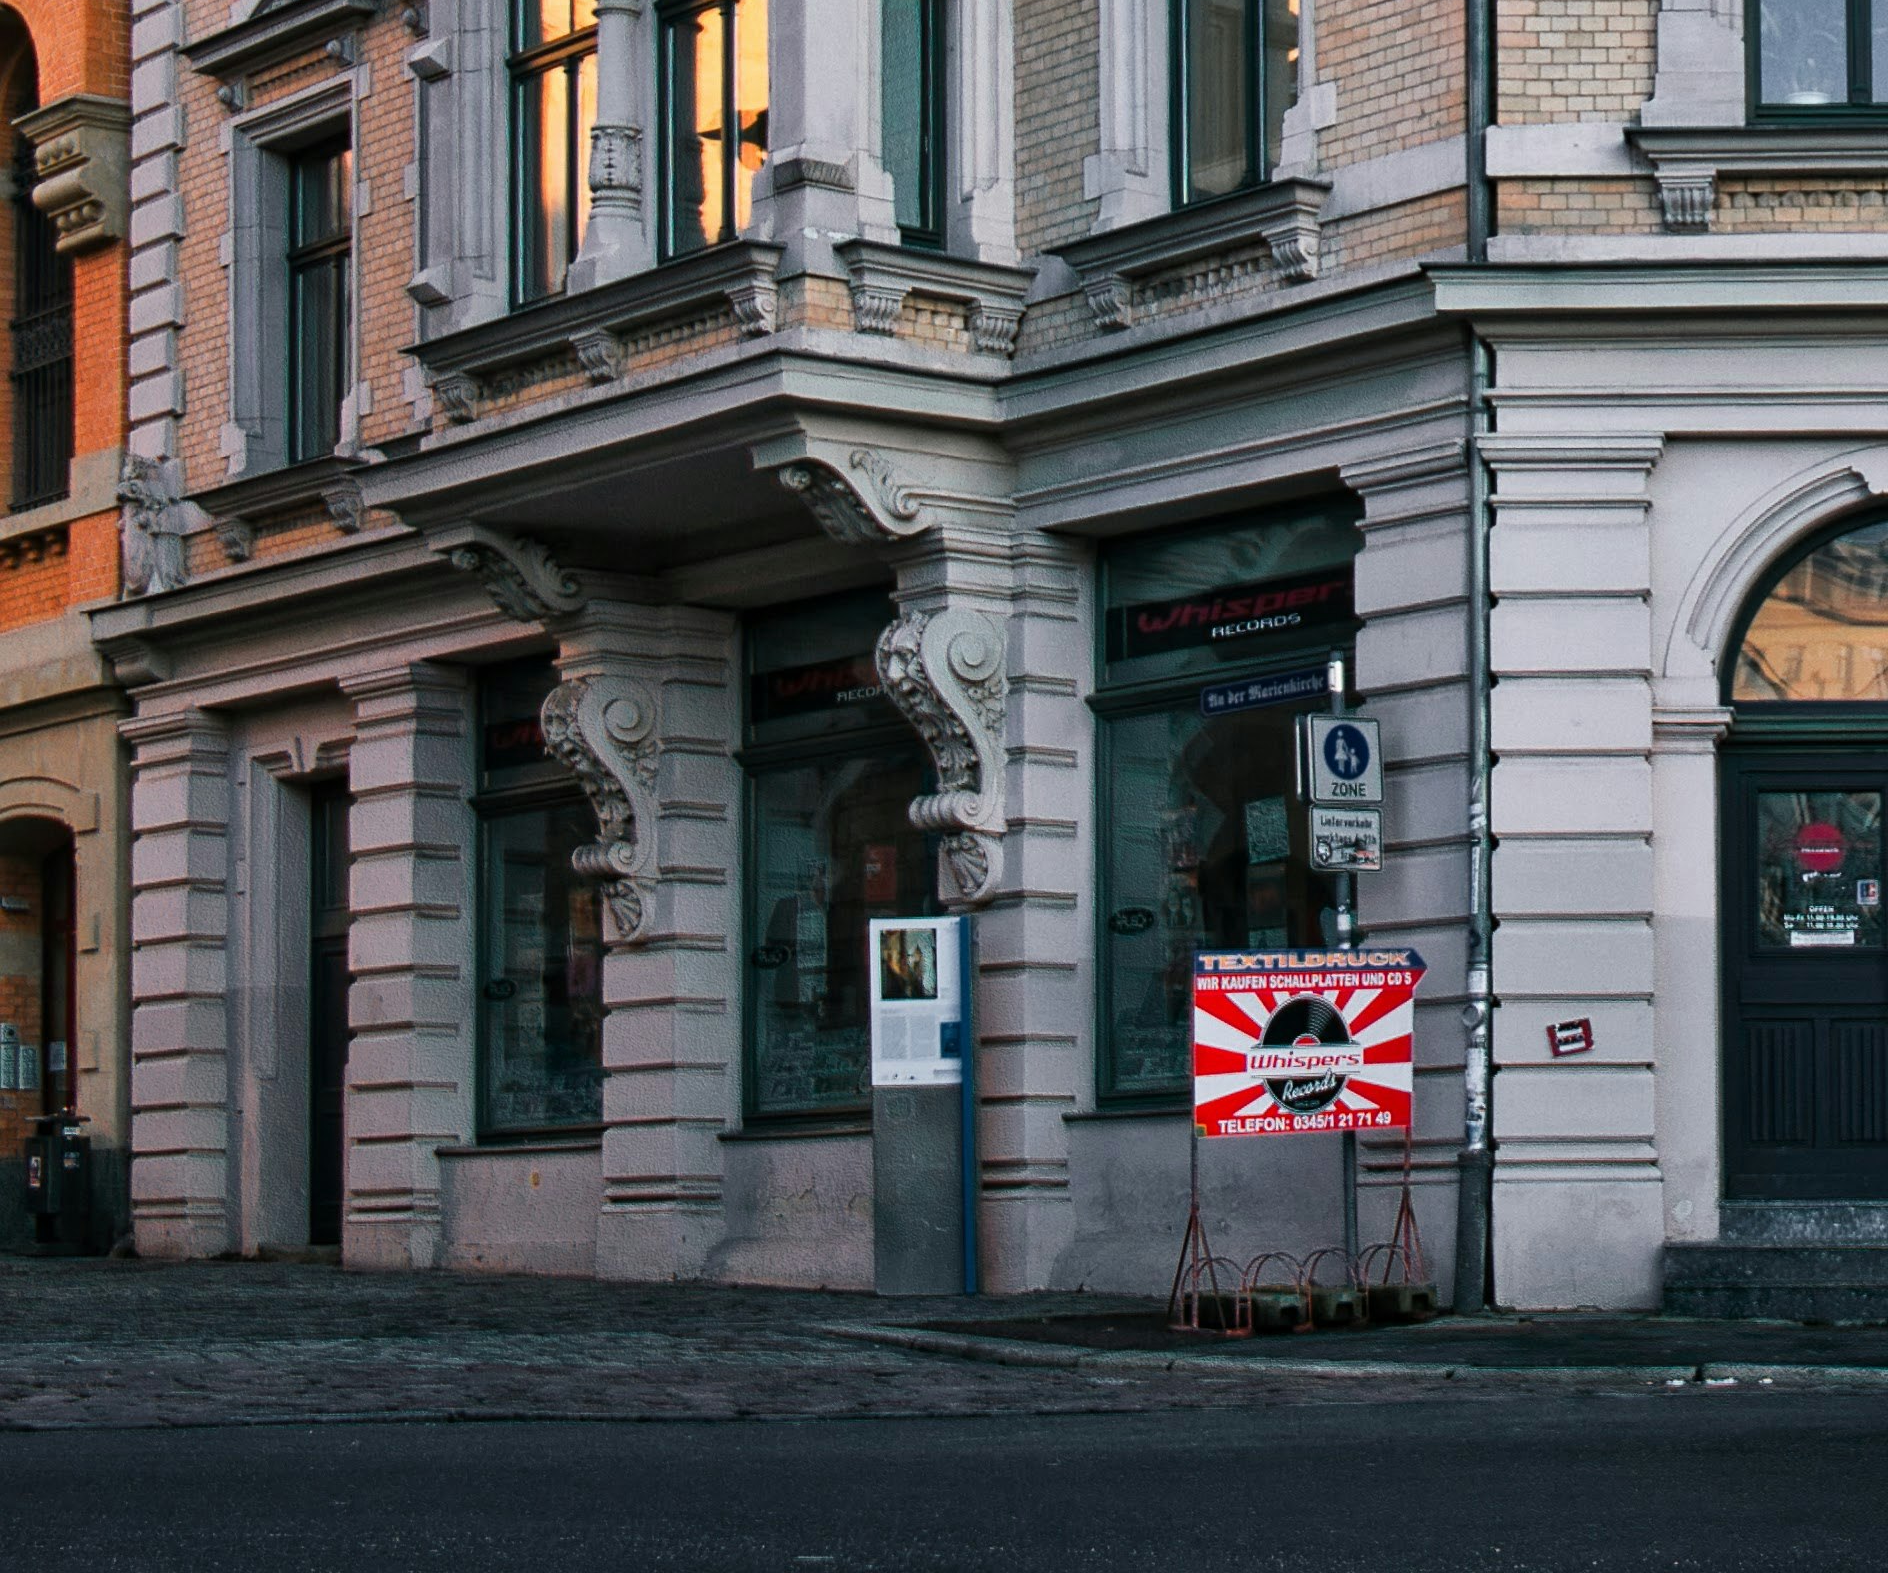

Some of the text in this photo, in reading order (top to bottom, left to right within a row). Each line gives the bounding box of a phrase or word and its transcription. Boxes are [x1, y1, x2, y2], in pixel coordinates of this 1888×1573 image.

[1137, 581, 1352, 634] Whisper
[1210, 612, 1302, 639] RECORDS
[1207, 674, 1324, 708] An der Marienkirche
[1330, 782, 1367, 797] ZONE
[1199, 951, 1411, 971] TEXTILDRUCK
[1197, 976, 1219, 991] WIR
[1220, 974, 1267, 990] KAUFEN
[1269, 973, 1359, 989] SCHALLPLATTEN
[1361, 972, 1385, 986] UND
[1250, 1051, 1361, 1070] Whispers
[1218, 1111, 1392, 1134] TELEFON: 0345/1 21 71 49
